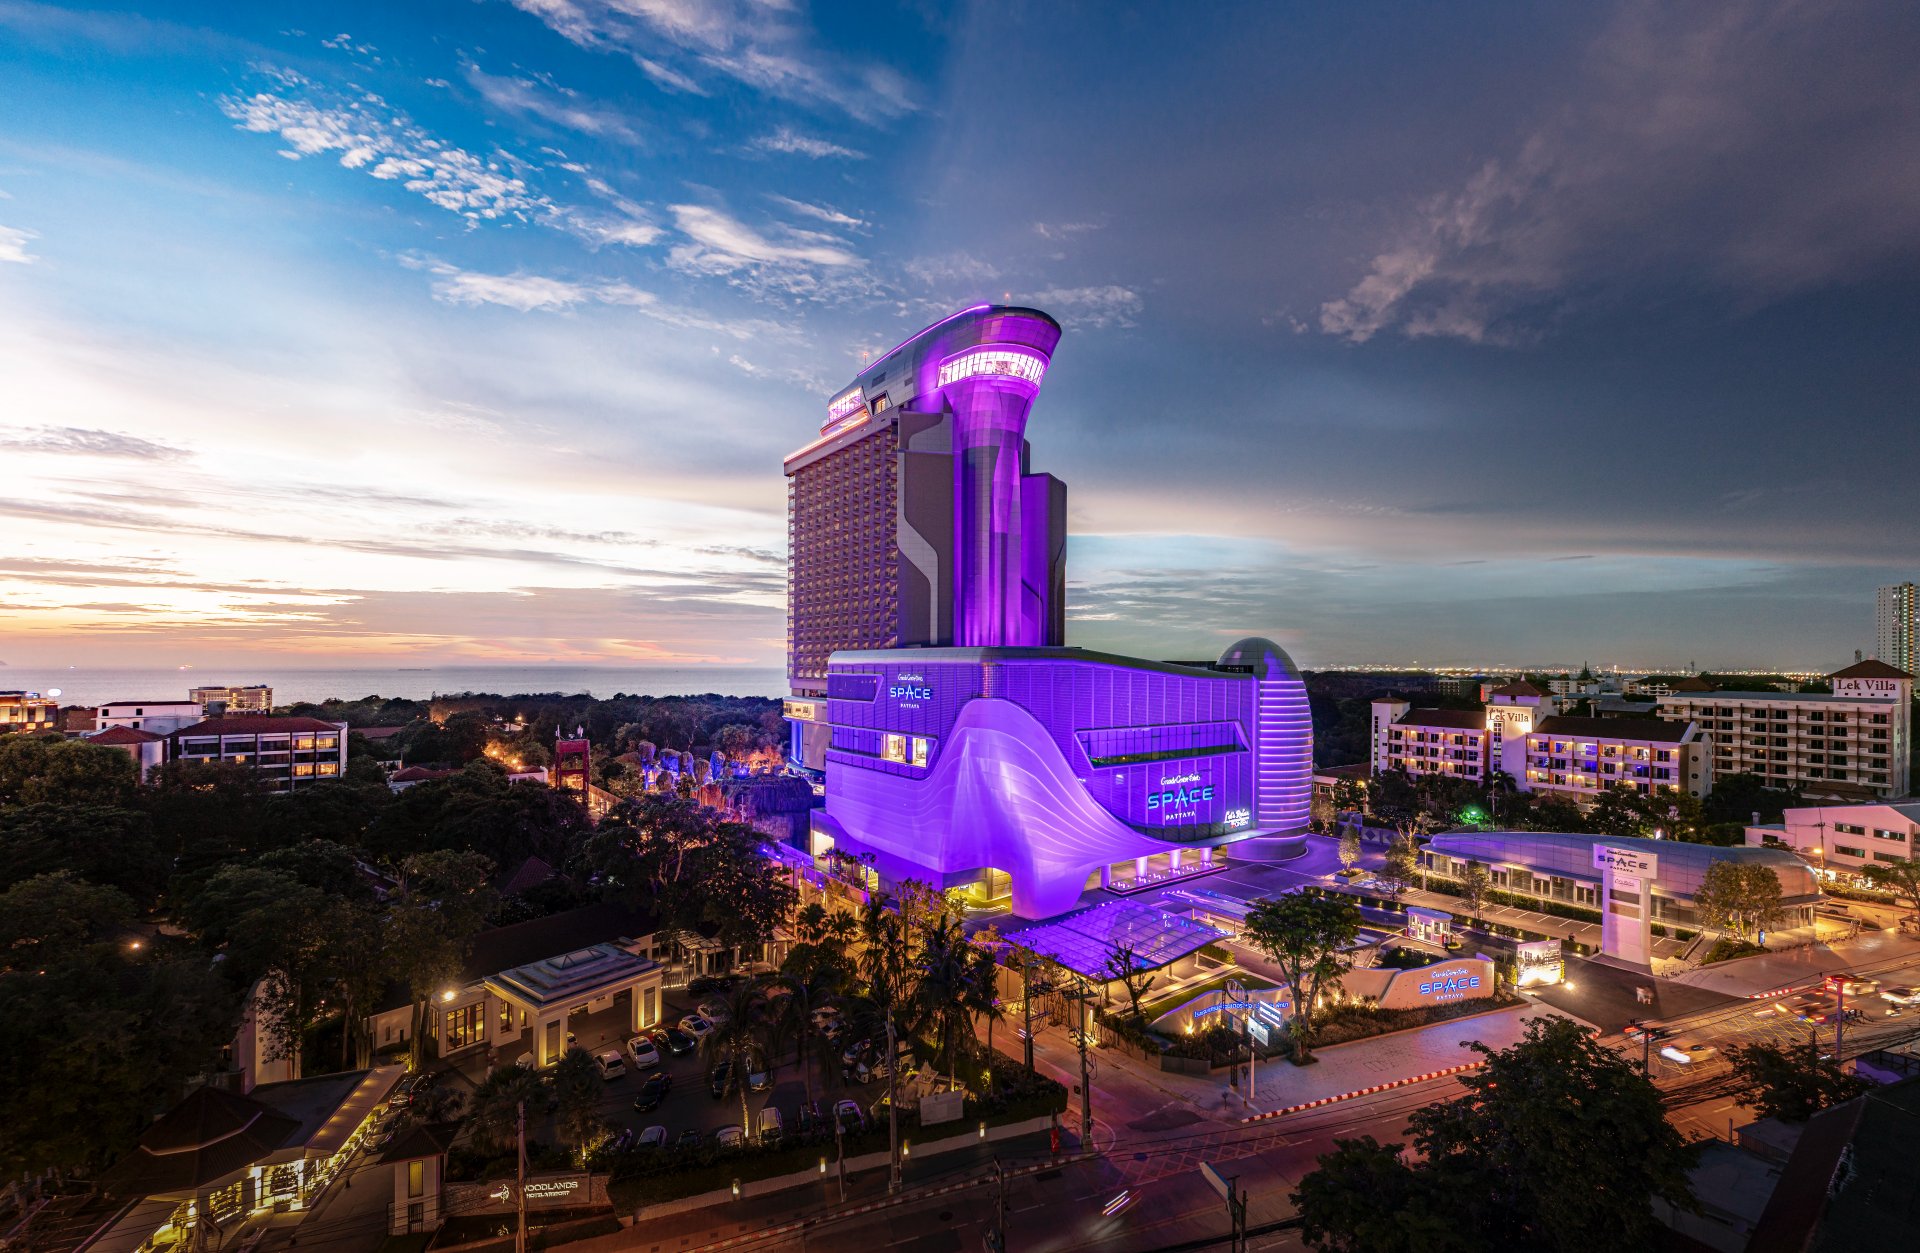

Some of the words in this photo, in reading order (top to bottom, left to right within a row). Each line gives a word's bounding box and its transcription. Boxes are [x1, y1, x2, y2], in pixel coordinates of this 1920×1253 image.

[890, 684, 930, 700] SPACE
[1837, 679, 1861, 690] Lek
[1865, 679, 1896, 691] Villa
[1507, 712, 1529, 722] Villa
[1148, 787, 1213, 810] SPACE
[1165, 811, 1196, 821] PATTAYA
[1598, 855, 1648, 870] SPACE
[1420, 976, 1480, 995] SPACE
